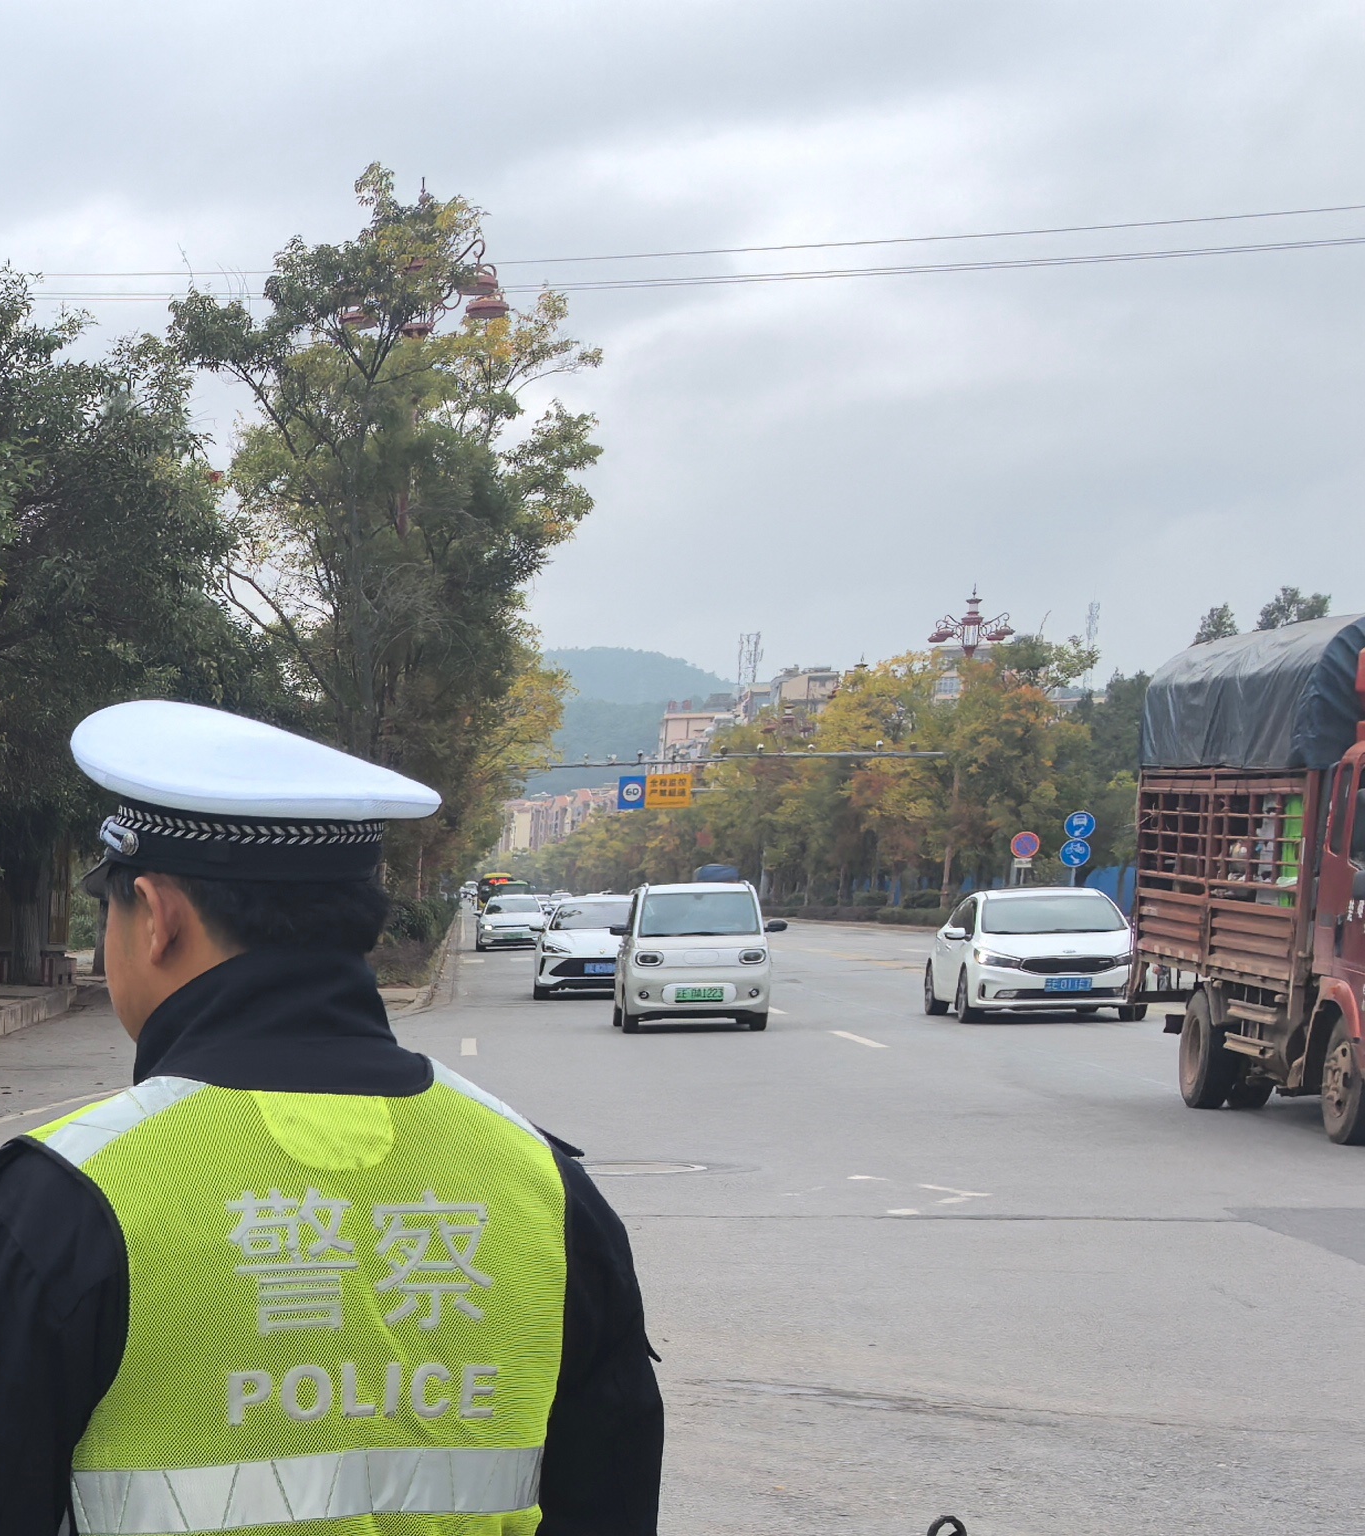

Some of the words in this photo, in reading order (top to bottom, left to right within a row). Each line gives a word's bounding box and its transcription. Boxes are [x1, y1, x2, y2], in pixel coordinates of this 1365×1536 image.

[625, 788, 640, 796] 60
[225, 1186, 493, 1338] 警察
[226, 1361, 499, 1428] POLICE
